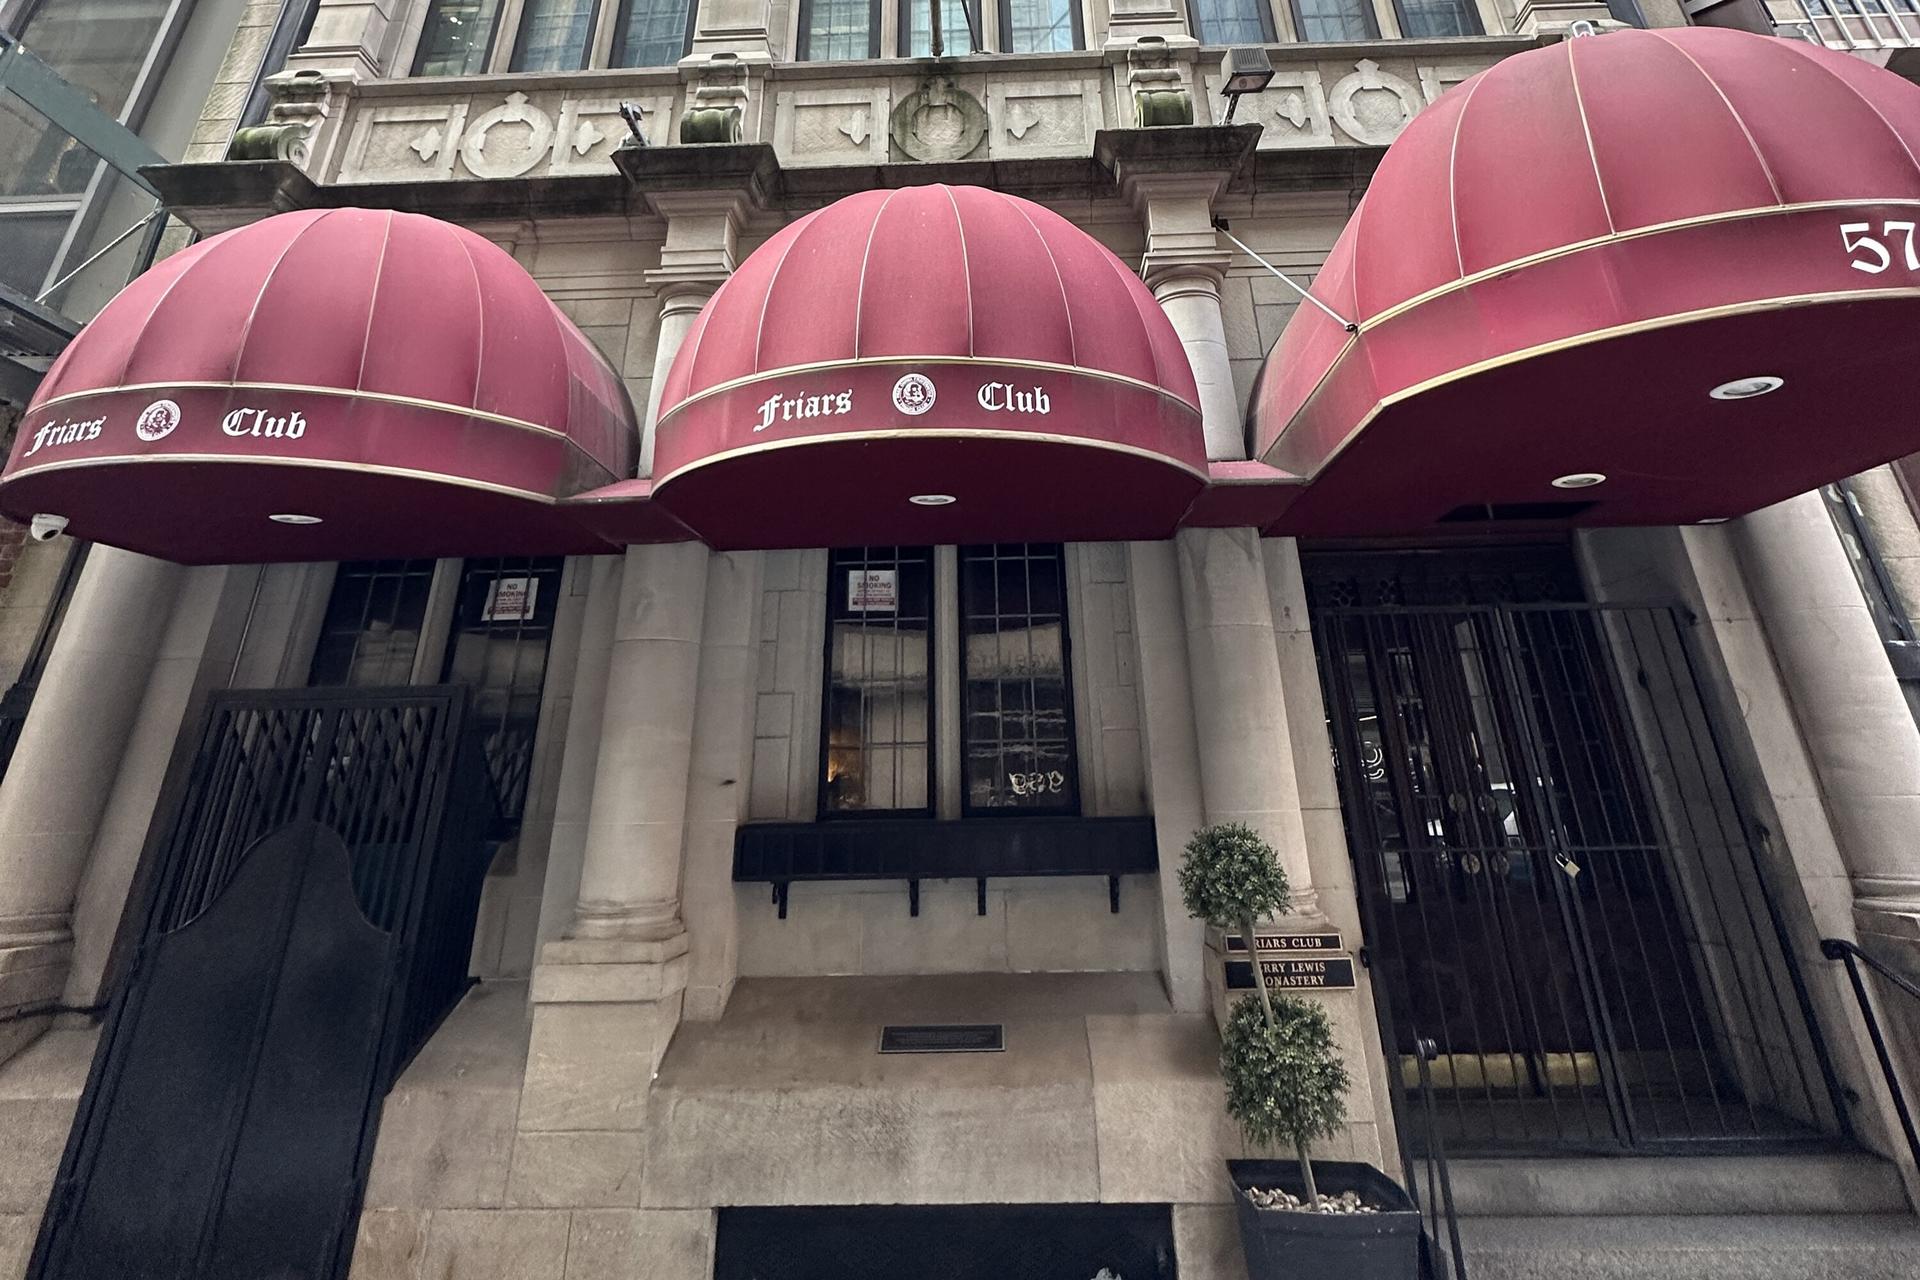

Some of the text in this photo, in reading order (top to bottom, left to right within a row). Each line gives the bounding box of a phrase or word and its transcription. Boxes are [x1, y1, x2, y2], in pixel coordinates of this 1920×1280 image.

[1839, 221, 1920, 274] 57
[752, 388, 853, 432] Friars
[977, 381, 1051, 415] Club
[23, 415, 107, 457] Friars
[222, 407, 307, 440] Club
[1254, 938, 1322, 948] RIARS CLUB
[1259, 962, 1326, 973] RRY LEWIS
[1265, 975, 1325, 986] ONASTERY
